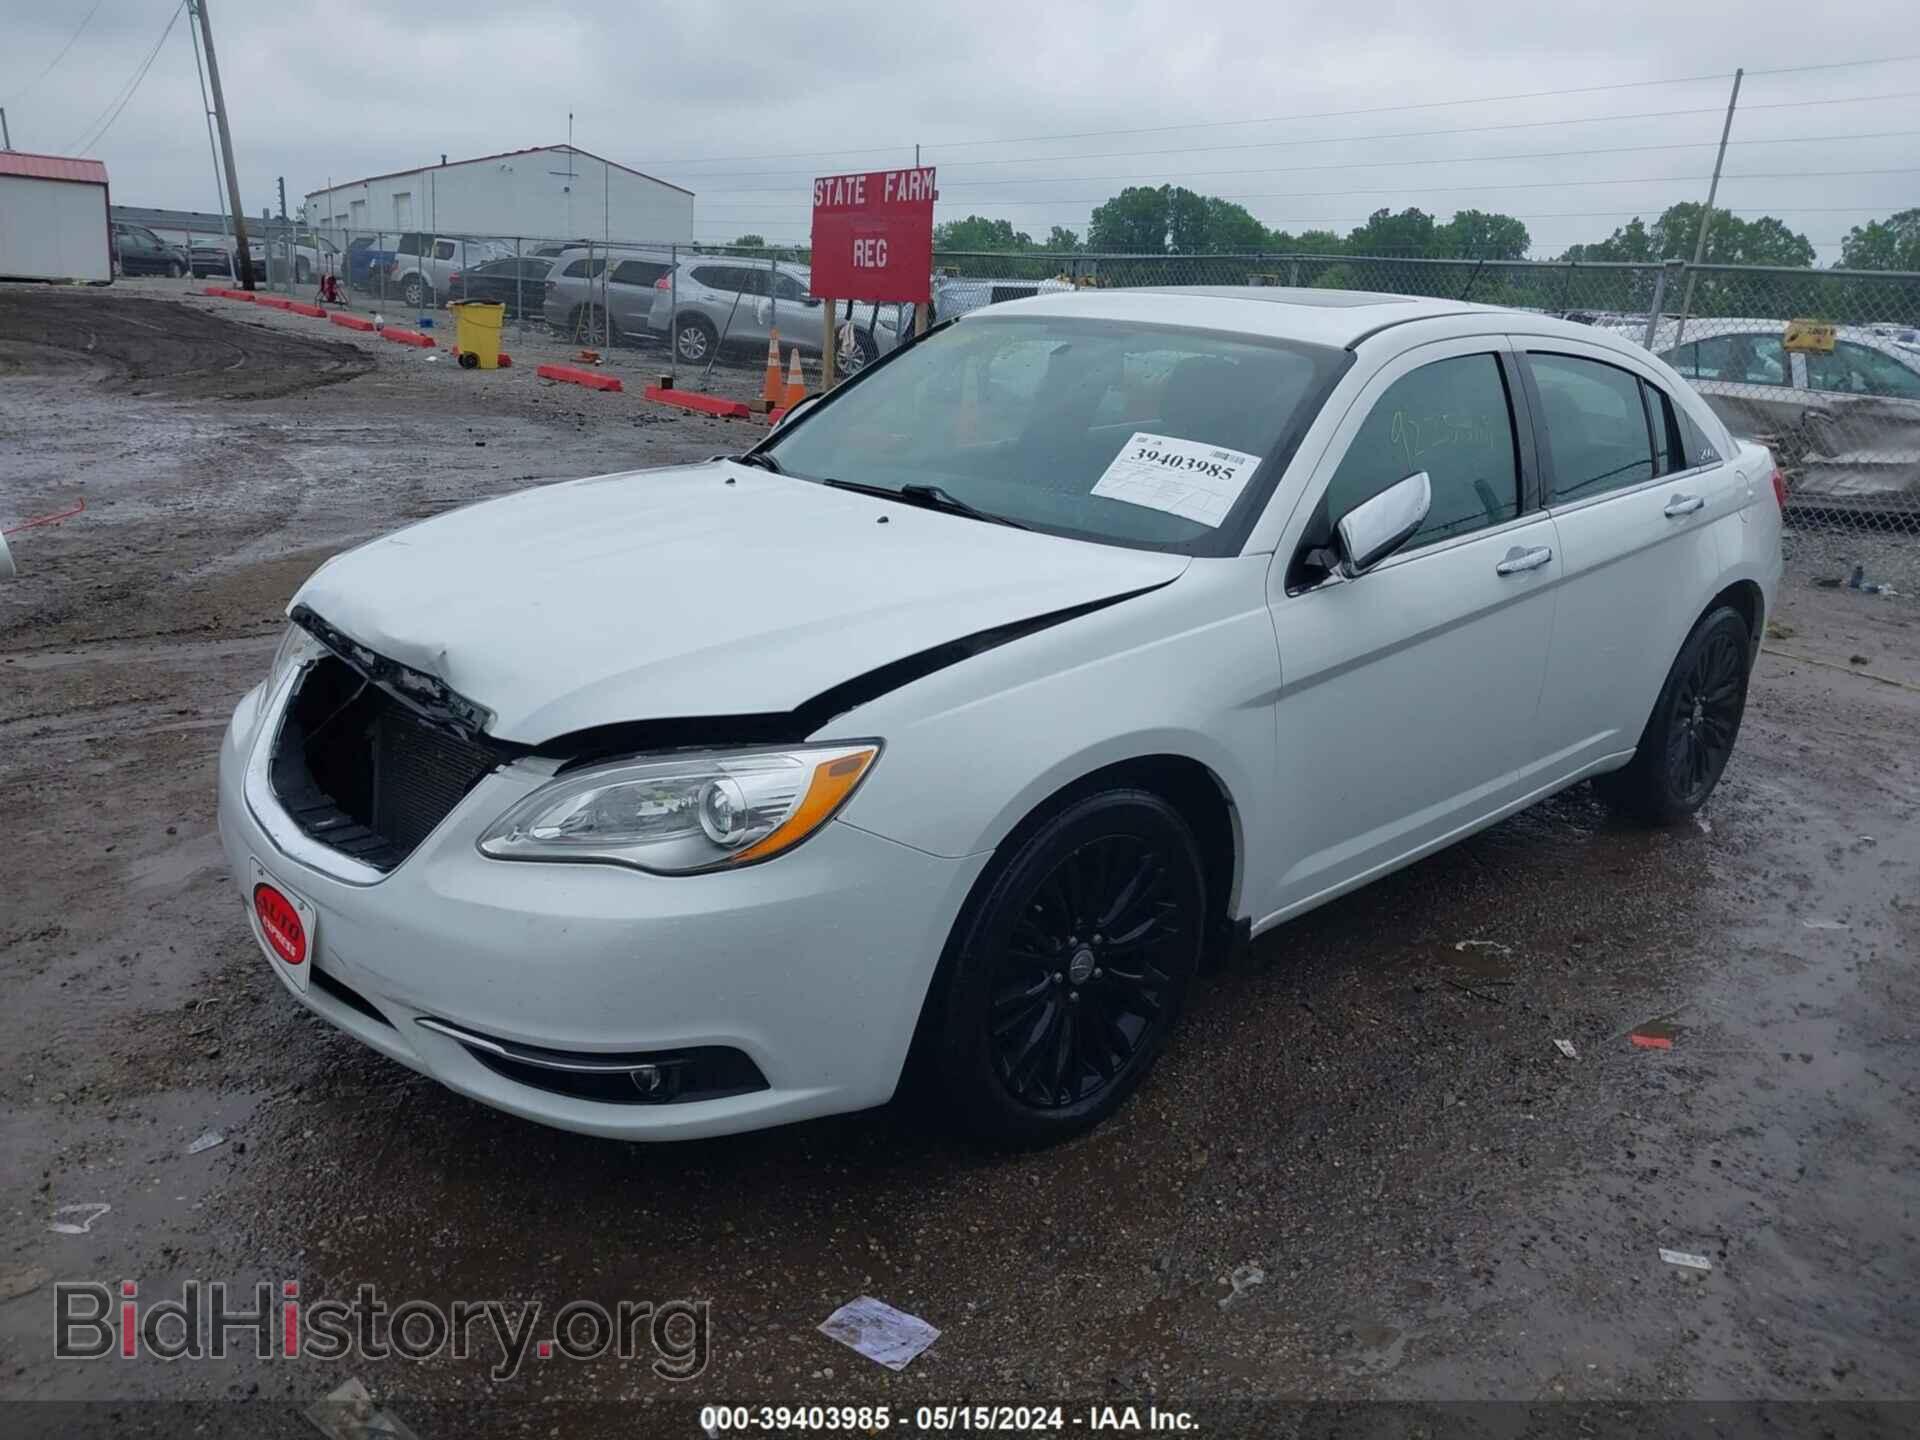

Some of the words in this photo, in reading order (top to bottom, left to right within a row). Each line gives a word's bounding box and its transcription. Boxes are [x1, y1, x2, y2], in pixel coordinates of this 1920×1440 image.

[814, 176, 866, 207] STATE
[884, 169, 934, 202] FARM
[1130, 447, 1236, 481] 39403985
